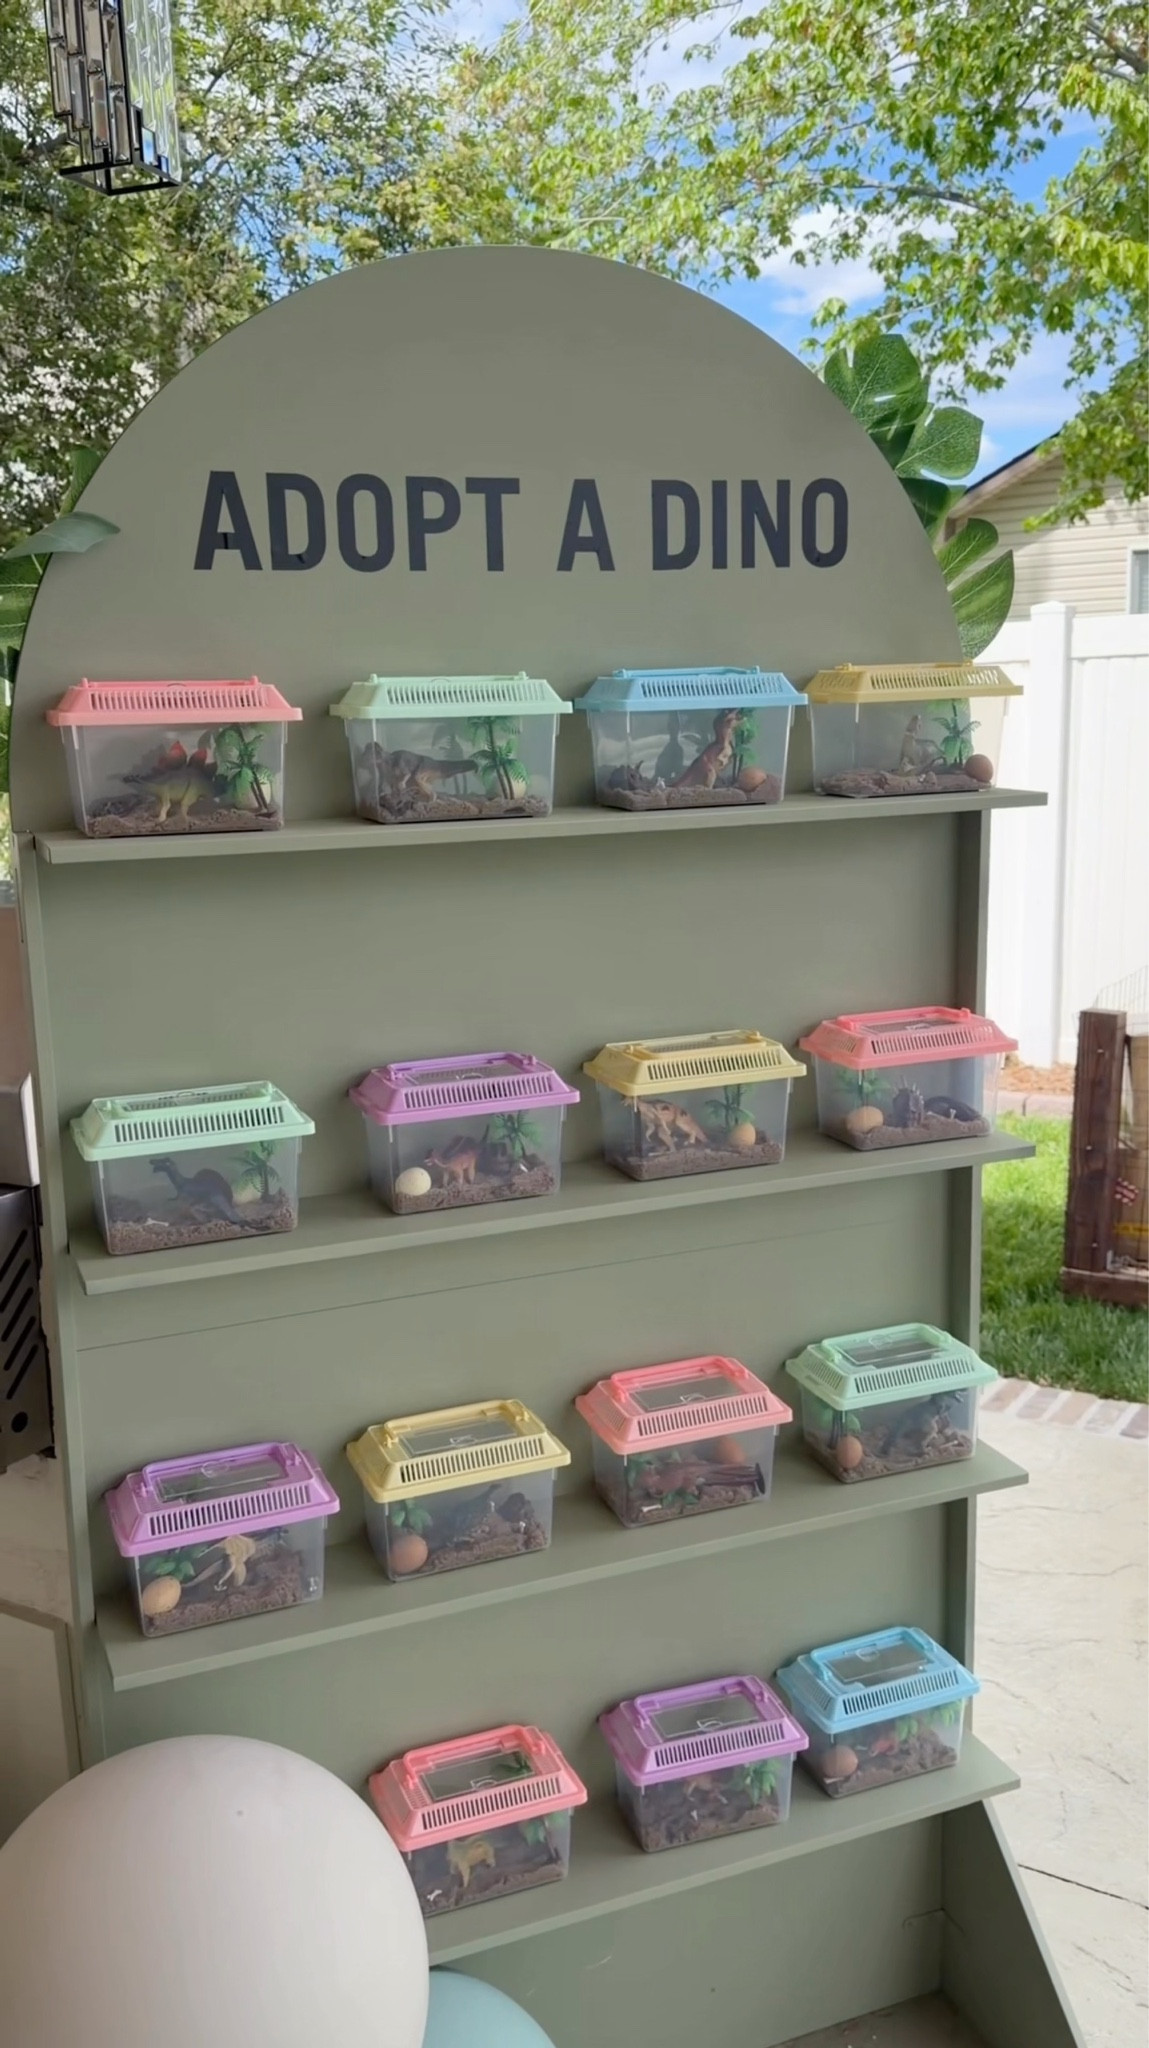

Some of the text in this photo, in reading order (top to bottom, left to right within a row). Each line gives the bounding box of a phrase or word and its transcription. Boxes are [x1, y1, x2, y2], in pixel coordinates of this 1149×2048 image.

[194, 470, 848, 572] ADOPT A DINO
